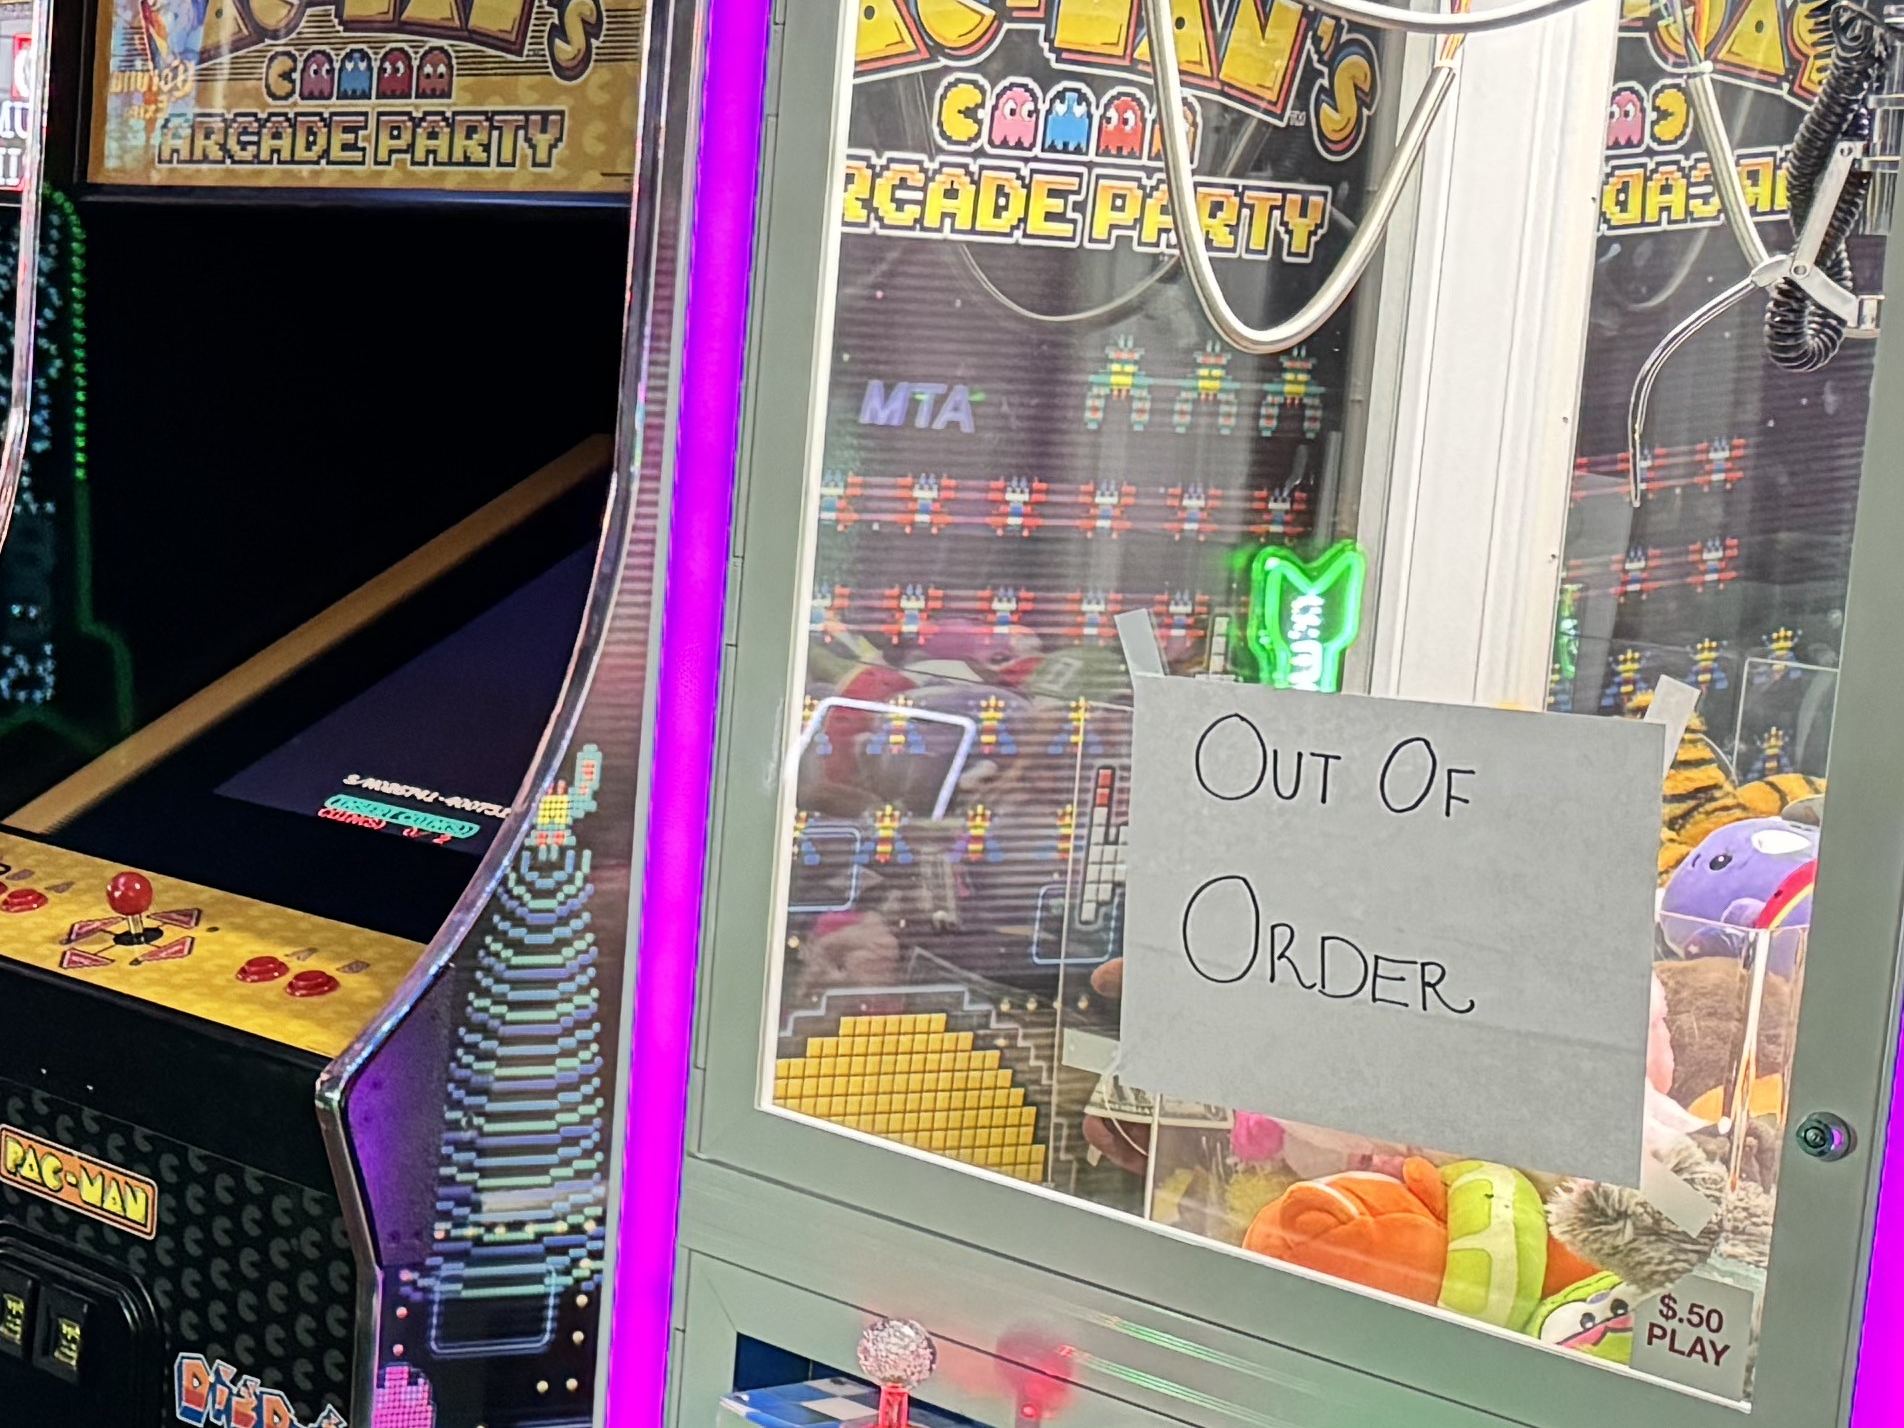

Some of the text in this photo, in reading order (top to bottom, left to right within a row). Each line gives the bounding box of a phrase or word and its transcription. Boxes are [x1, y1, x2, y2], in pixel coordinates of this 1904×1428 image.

[156, 107, 568, 169] ARCADE PARTY
[1091, 174, 1330, 258] PARTY
[1195, 712, 1477, 818] OUT OF
[1182, 874, 1476, 1016] ORDER
[3, 1138, 154, 1234] PAC-MAN
[1645, 1323, 1732, 1370] PLAY
[1659, 1292, 1726, 1336] $.50
